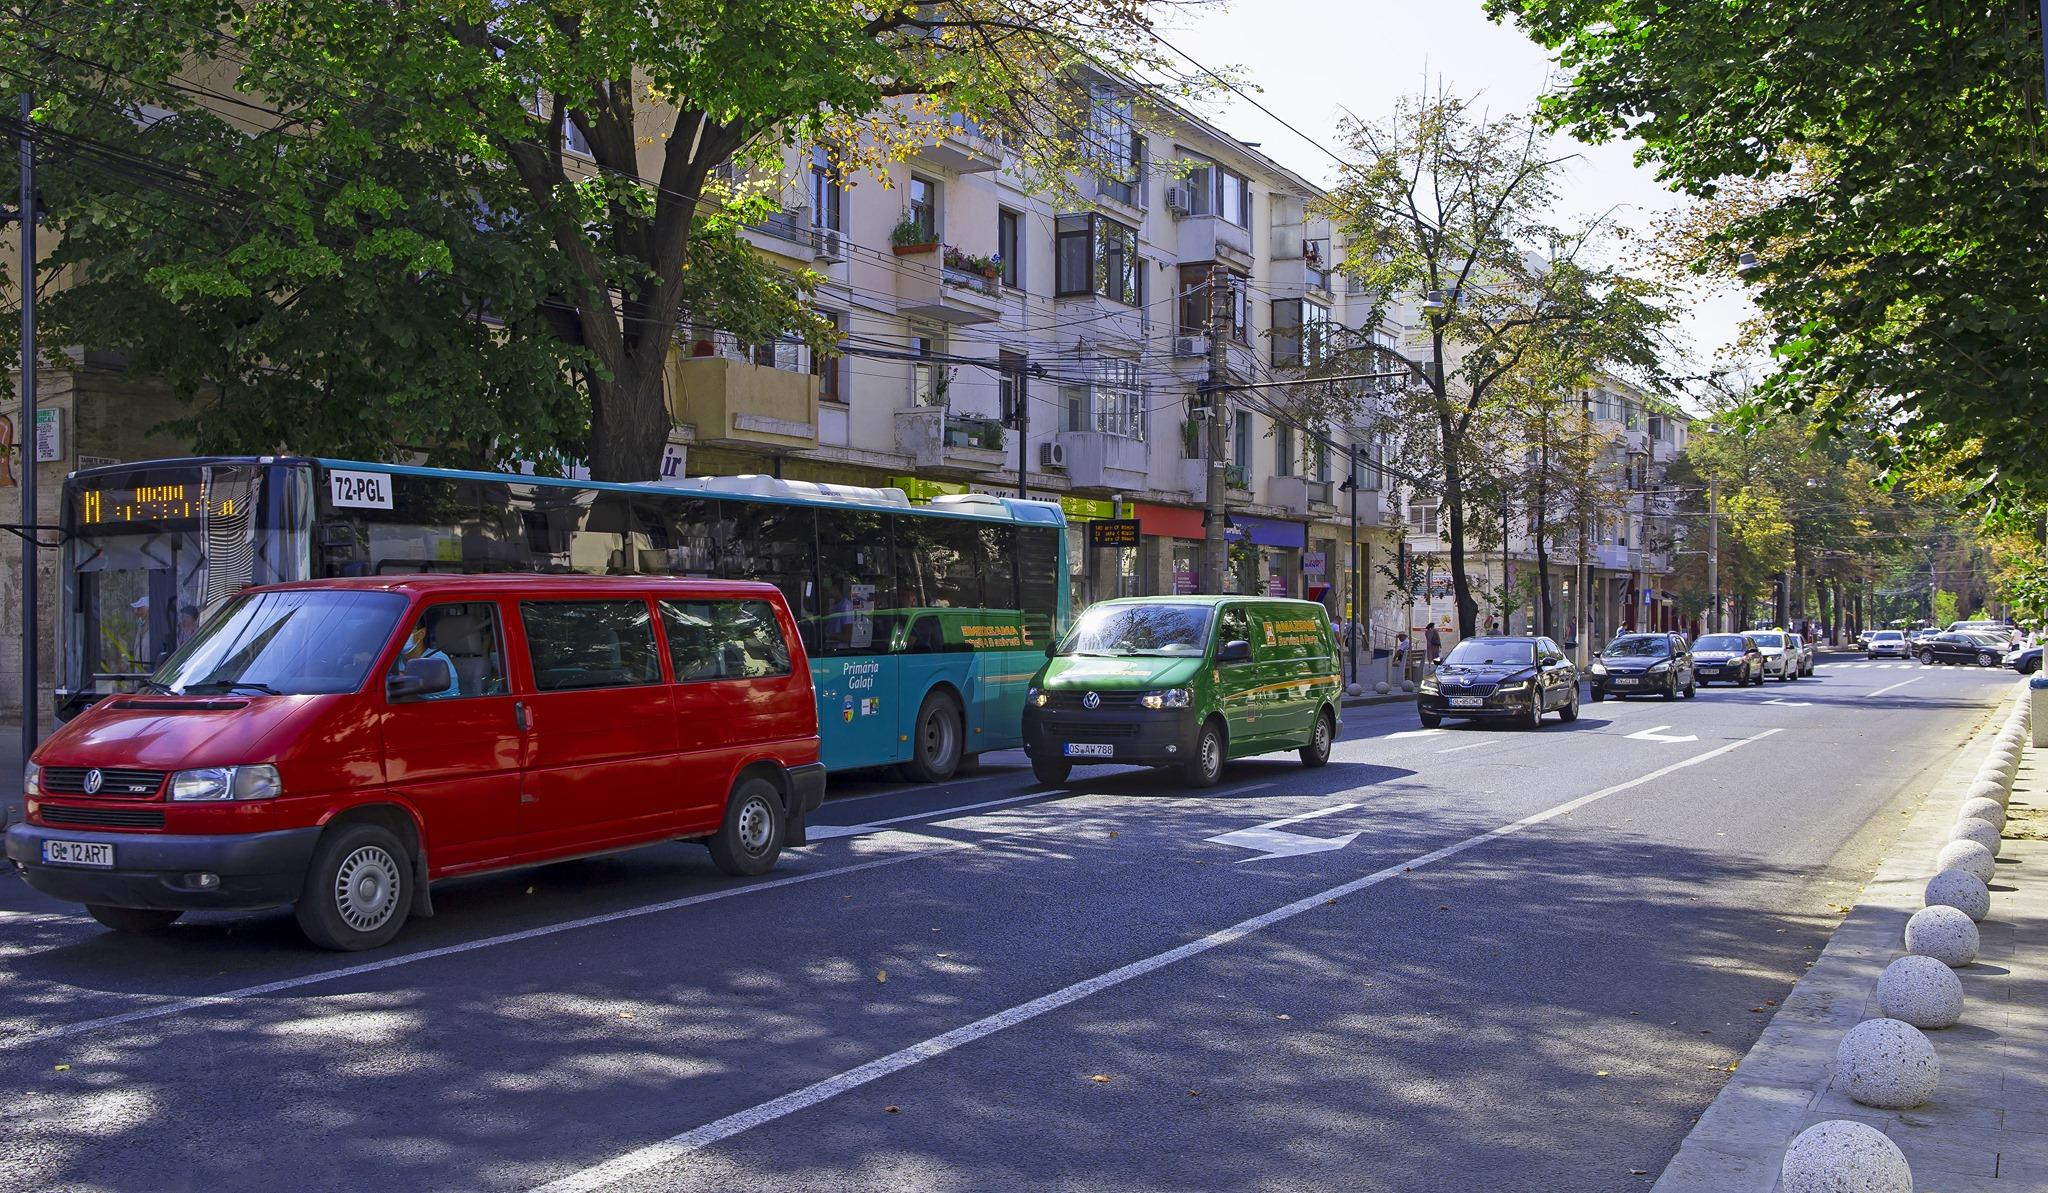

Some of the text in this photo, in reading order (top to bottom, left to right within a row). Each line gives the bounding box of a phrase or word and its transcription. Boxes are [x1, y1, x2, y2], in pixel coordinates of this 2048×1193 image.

[335, 476, 385, 502] 72-PGL
[1070, 745, 1080, 753] OS
[51, 842, 67, 860] GL
